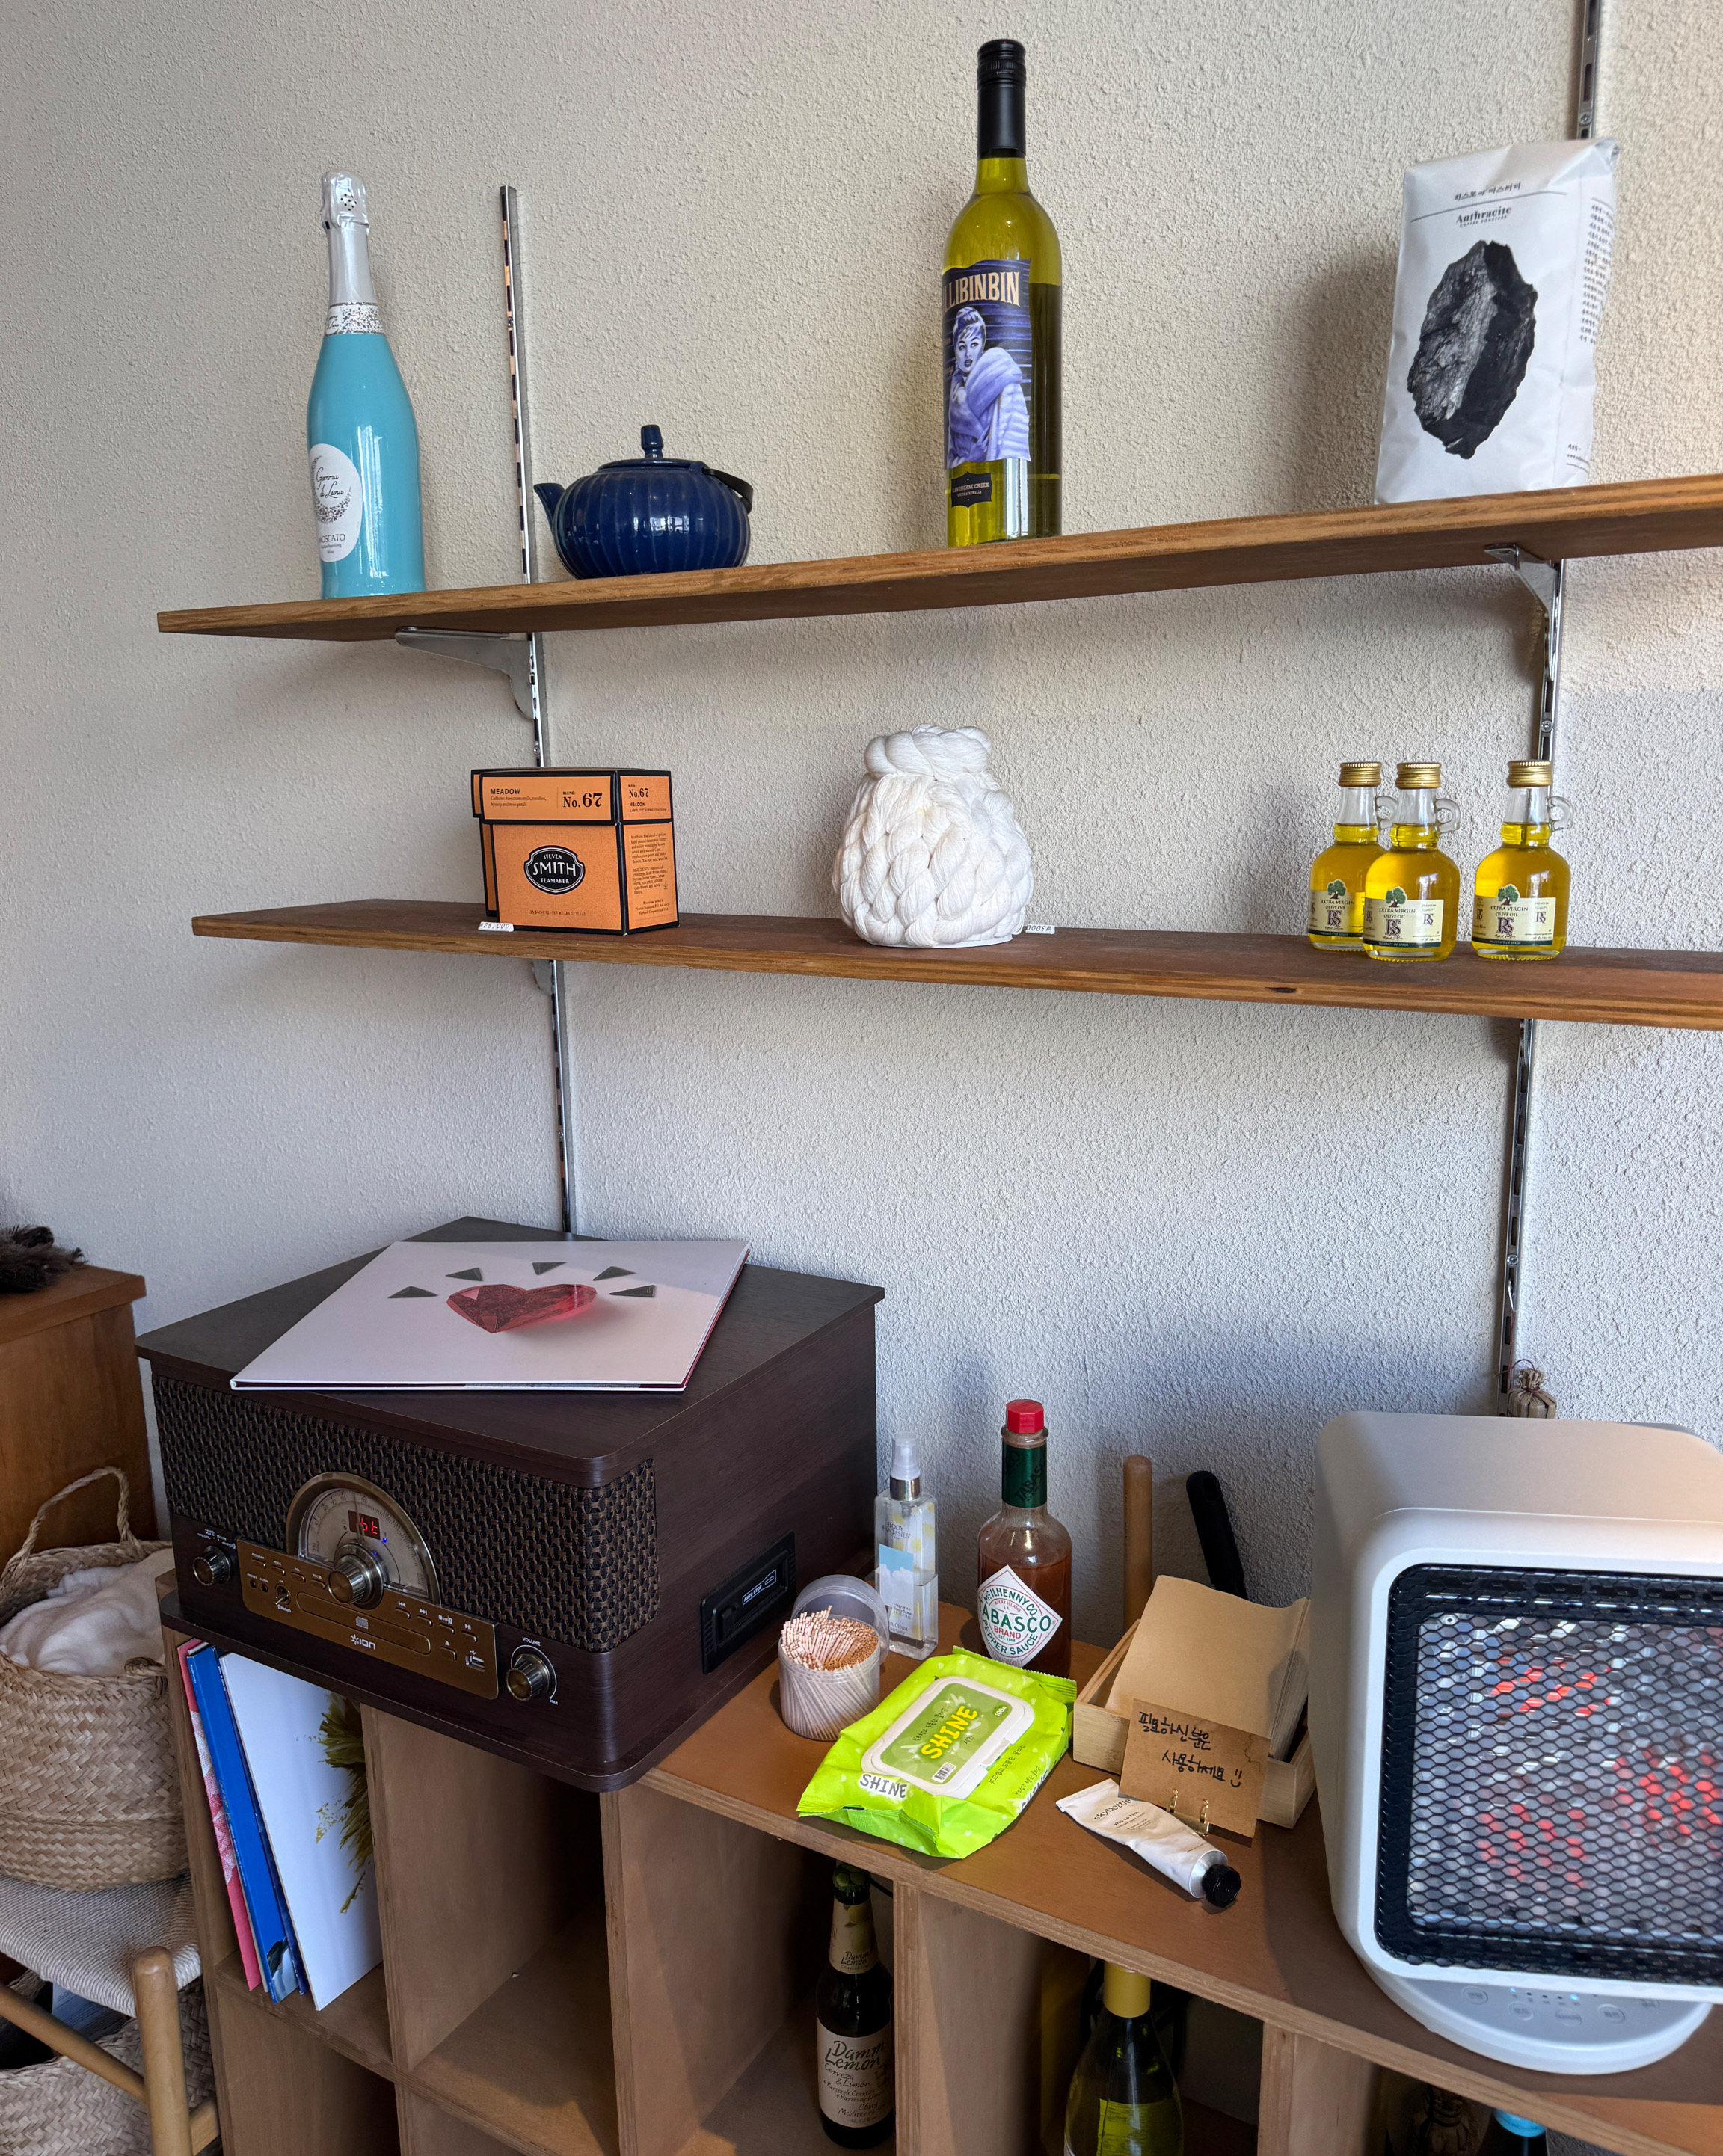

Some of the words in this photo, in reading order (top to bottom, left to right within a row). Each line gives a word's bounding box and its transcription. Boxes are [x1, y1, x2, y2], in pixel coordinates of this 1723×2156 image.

[1455, 206, 1512, 224] Anthracite
[563, 796, 581, 808] No.
[582, 792, 603, 808] 67
[532, 862, 577, 876] SMITH
[743, 1591, 754, 1602] AUTO
[753, 1585, 763, 1594] STOP
[890, 1627, 906, 1636] antasy
[983, 1619, 1007, 1654] PEPPER
[1010, 1633, 1038, 1655] SAUCE
[993, 1625, 1022, 1639] BRAND
[522, 1636, 541, 1646] VOLUME
[921, 1705, 978, 1760] SHINE
[1138, 1710, 1189, 1742] 필요하신
[1188, 1727, 1211, 1751] 분은
[1161, 1750, 1226, 1782] 사용하세요
[859, 1773, 908, 1799] SHINE
[1093, 1799, 1132, 1820] skybottle
[841, 1956, 867, 1966] Lemon
[825, 2048, 880, 2071] Lemon
[832, 2040, 885, 2061] Damm
[825, 2063, 854, 2080] Cerveza
